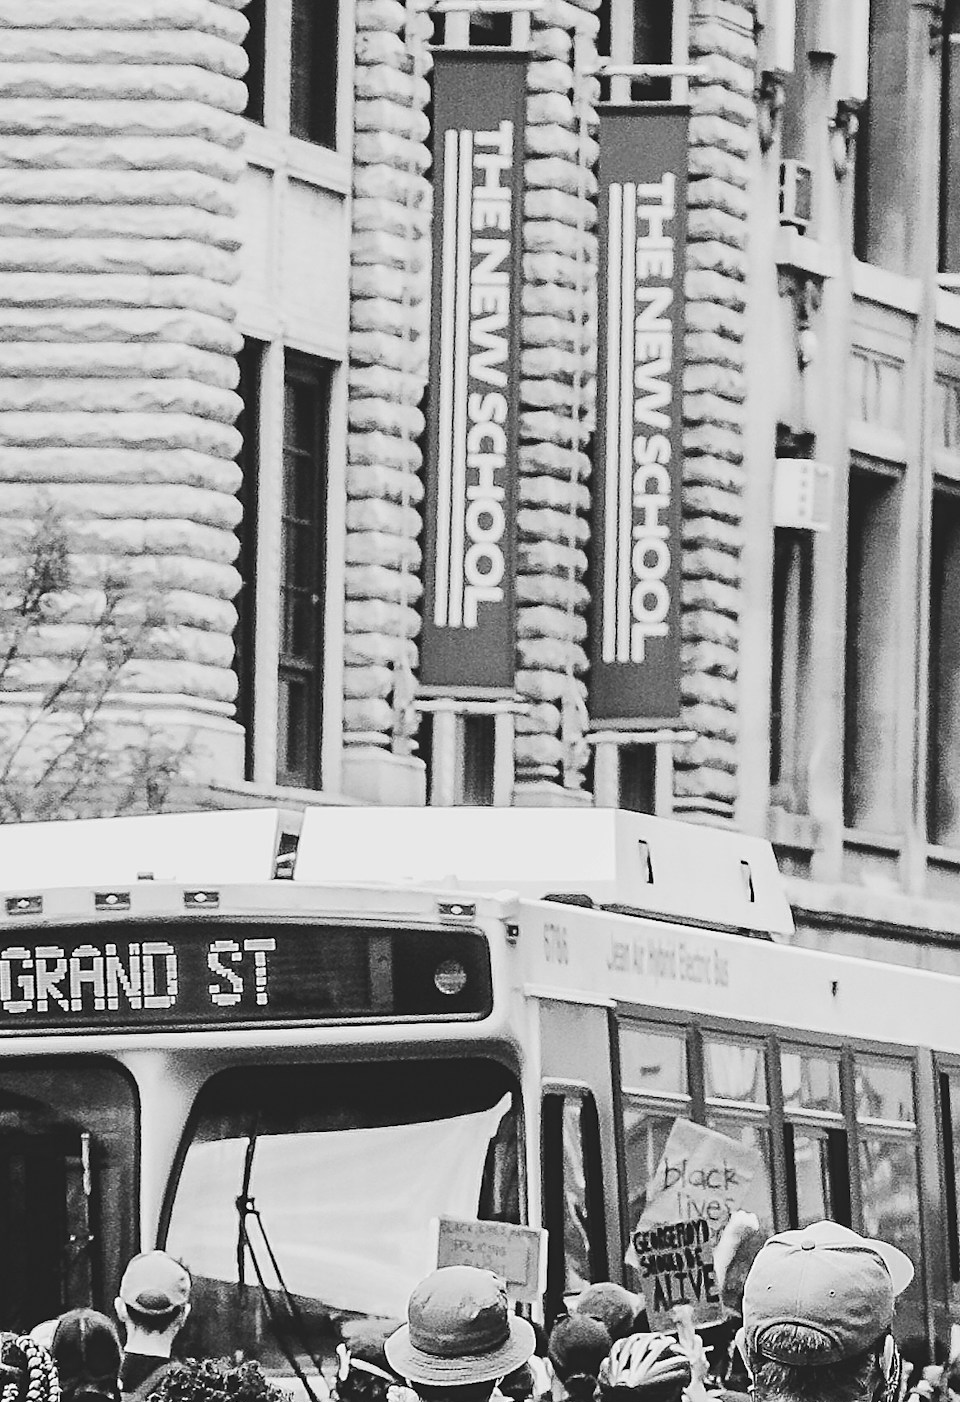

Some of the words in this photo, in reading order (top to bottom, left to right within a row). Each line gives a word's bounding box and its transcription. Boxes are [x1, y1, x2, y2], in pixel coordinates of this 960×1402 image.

[472, 120, 513, 231] THE
[636, 171, 675, 279] THE
[469, 238, 511, 387] NEW
[634, 287, 673, 429] NEW
[464, 392, 508, 629] SCHOOL
[631, 434, 671, 663] SCHOOL
[207, 938, 276, 1006] ST
[662, 1157, 739, 1191] black
[677, 1191, 734, 1223] lives
[653, 1263, 720, 1312] ALIVE
